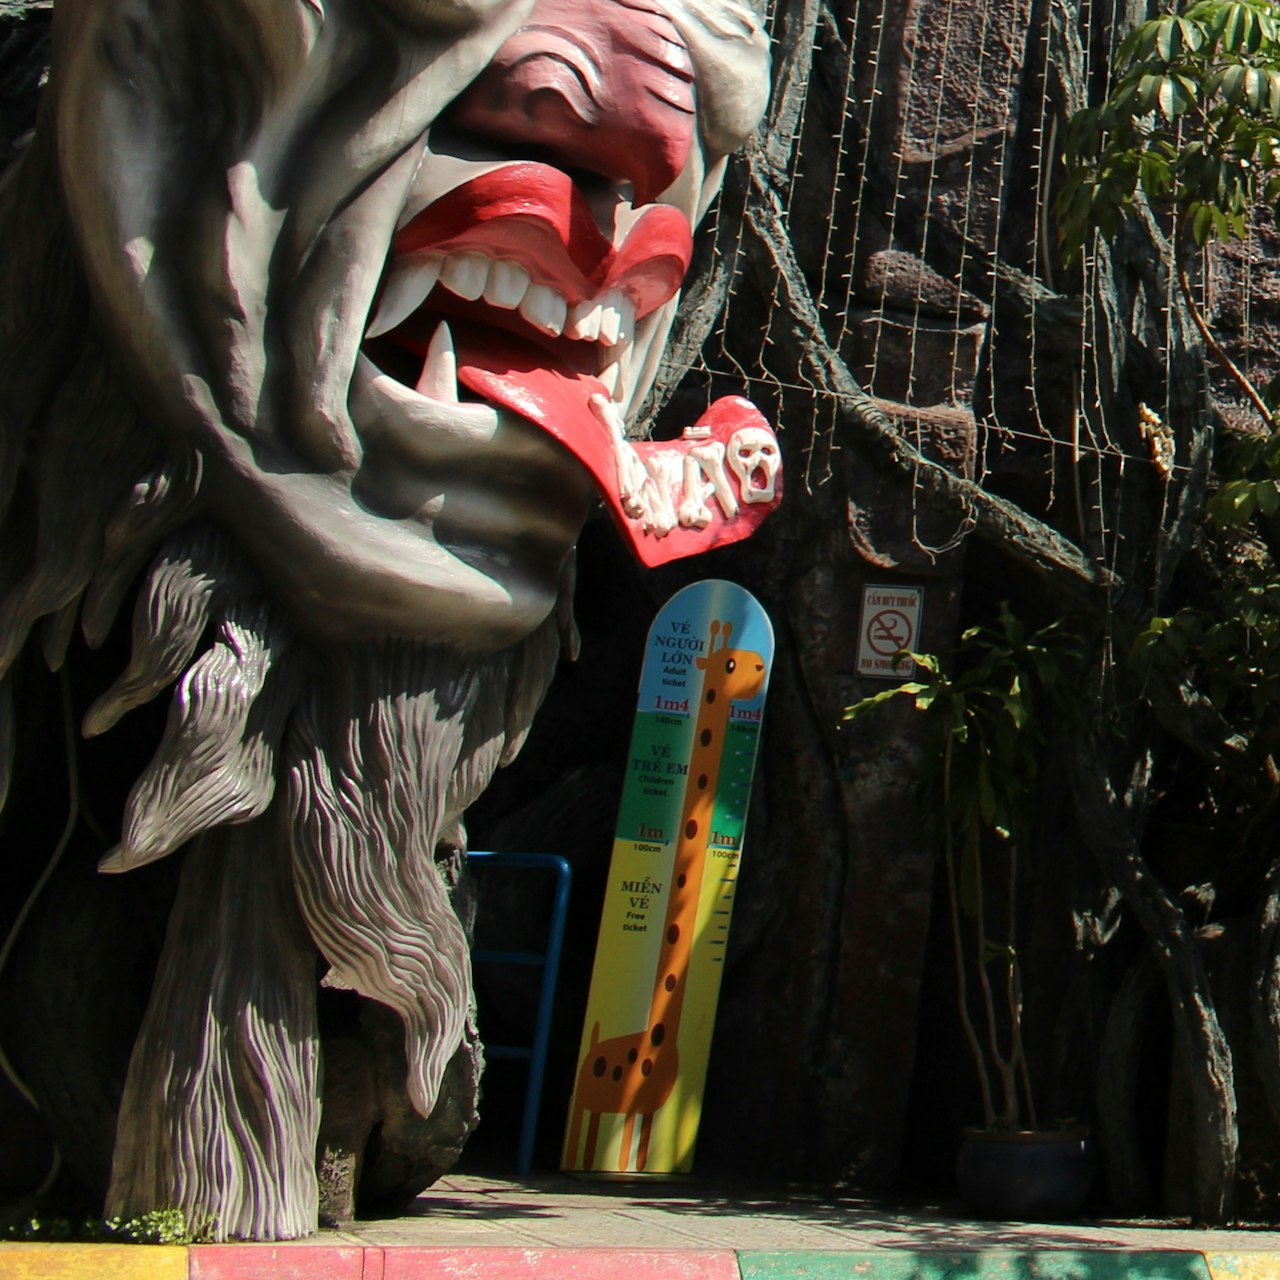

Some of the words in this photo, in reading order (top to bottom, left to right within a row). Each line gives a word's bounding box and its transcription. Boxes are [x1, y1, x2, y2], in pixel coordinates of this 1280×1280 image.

[671, 621, 691, 634] VÉ
[654, 635, 705, 652] NGƯỜI
[661, 650, 694, 665] LỚN
[663, 666, 687, 676] Adult
[662, 677, 686, 687] ticket
[655, 696, 689, 712] 1m4
[729, 705, 761, 720] 1m4
[655, 715, 682, 725] 140cm
[651, 744, 672, 758] VÉ
[632, 758, 662, 772] TRẺ
[666, 764, 689, 776] EM
[638, 774, 674, 785] Children
[643, 788, 668, 797] ticket
[637, 823, 663, 839] 1m
[711, 831, 736, 846] 1m
[634, 843, 662, 853] 100cm
[712, 850, 739, 859] 100cm
[621, 876, 662, 894] MIỄN
[629, 895, 650, 909] VÉ
[626, 911, 646, 920] Free
[623, 923, 648, 932] ticket
